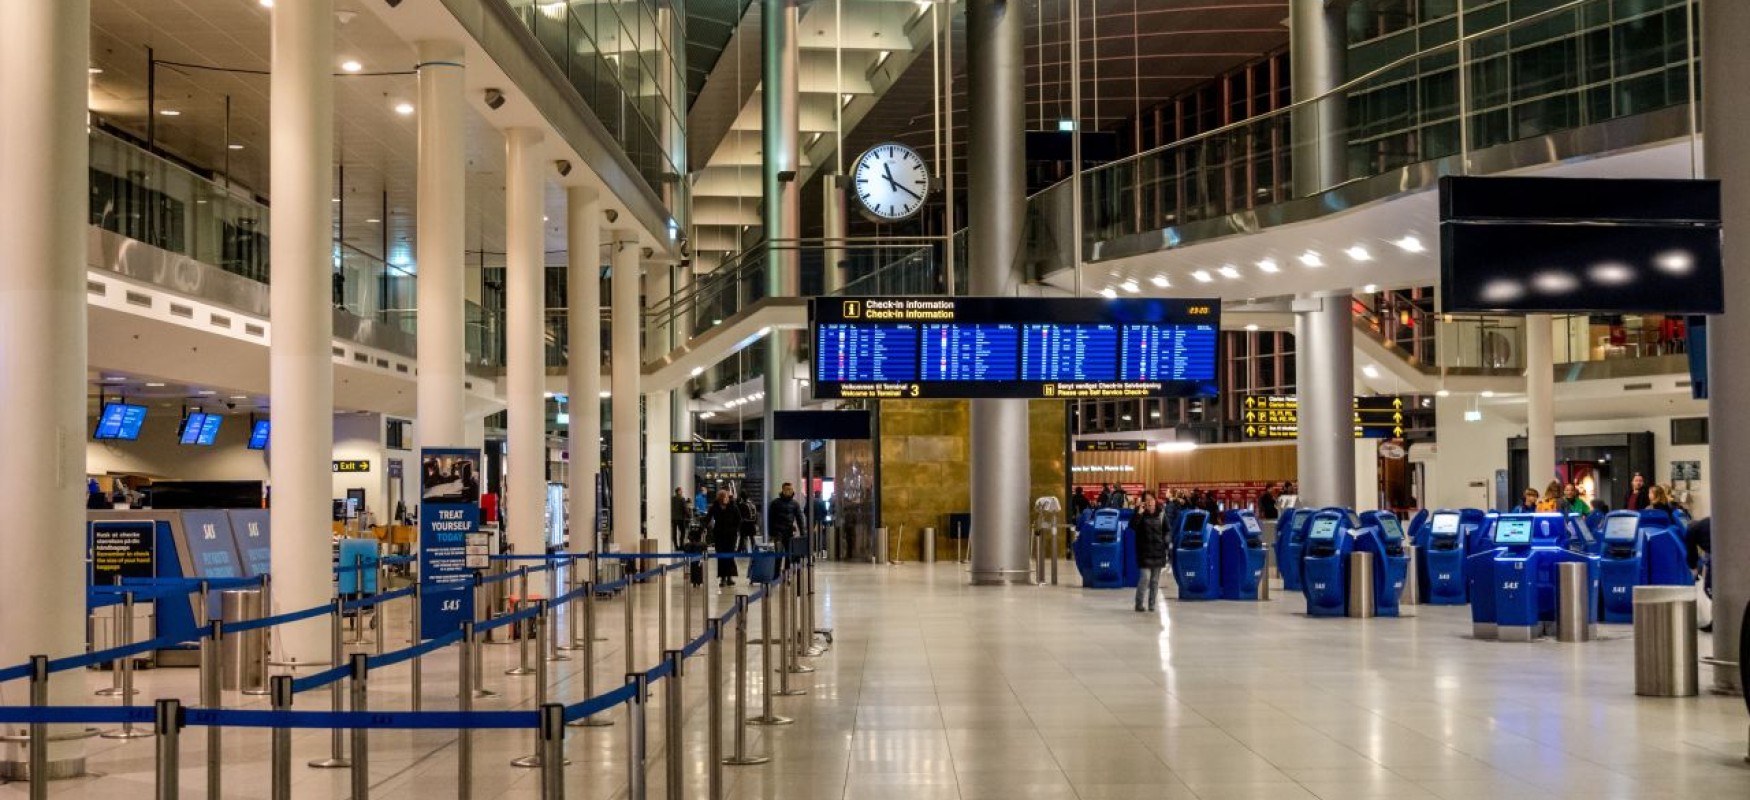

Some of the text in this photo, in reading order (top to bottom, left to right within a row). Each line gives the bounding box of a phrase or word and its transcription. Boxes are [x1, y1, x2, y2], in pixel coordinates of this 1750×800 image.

[866, 300, 904, 309] Check-in
[866, 310, 903, 319] Check-in
[911, 384, 919, 396] 3
[439, 510, 464, 519] TREAT
[203, 523, 216, 539] SAS
[248, 522, 259, 536] SAS
[432, 521, 472, 531] YOURSELF
[437, 532, 464, 542] TODAY
[441, 600, 461, 611] SAS
